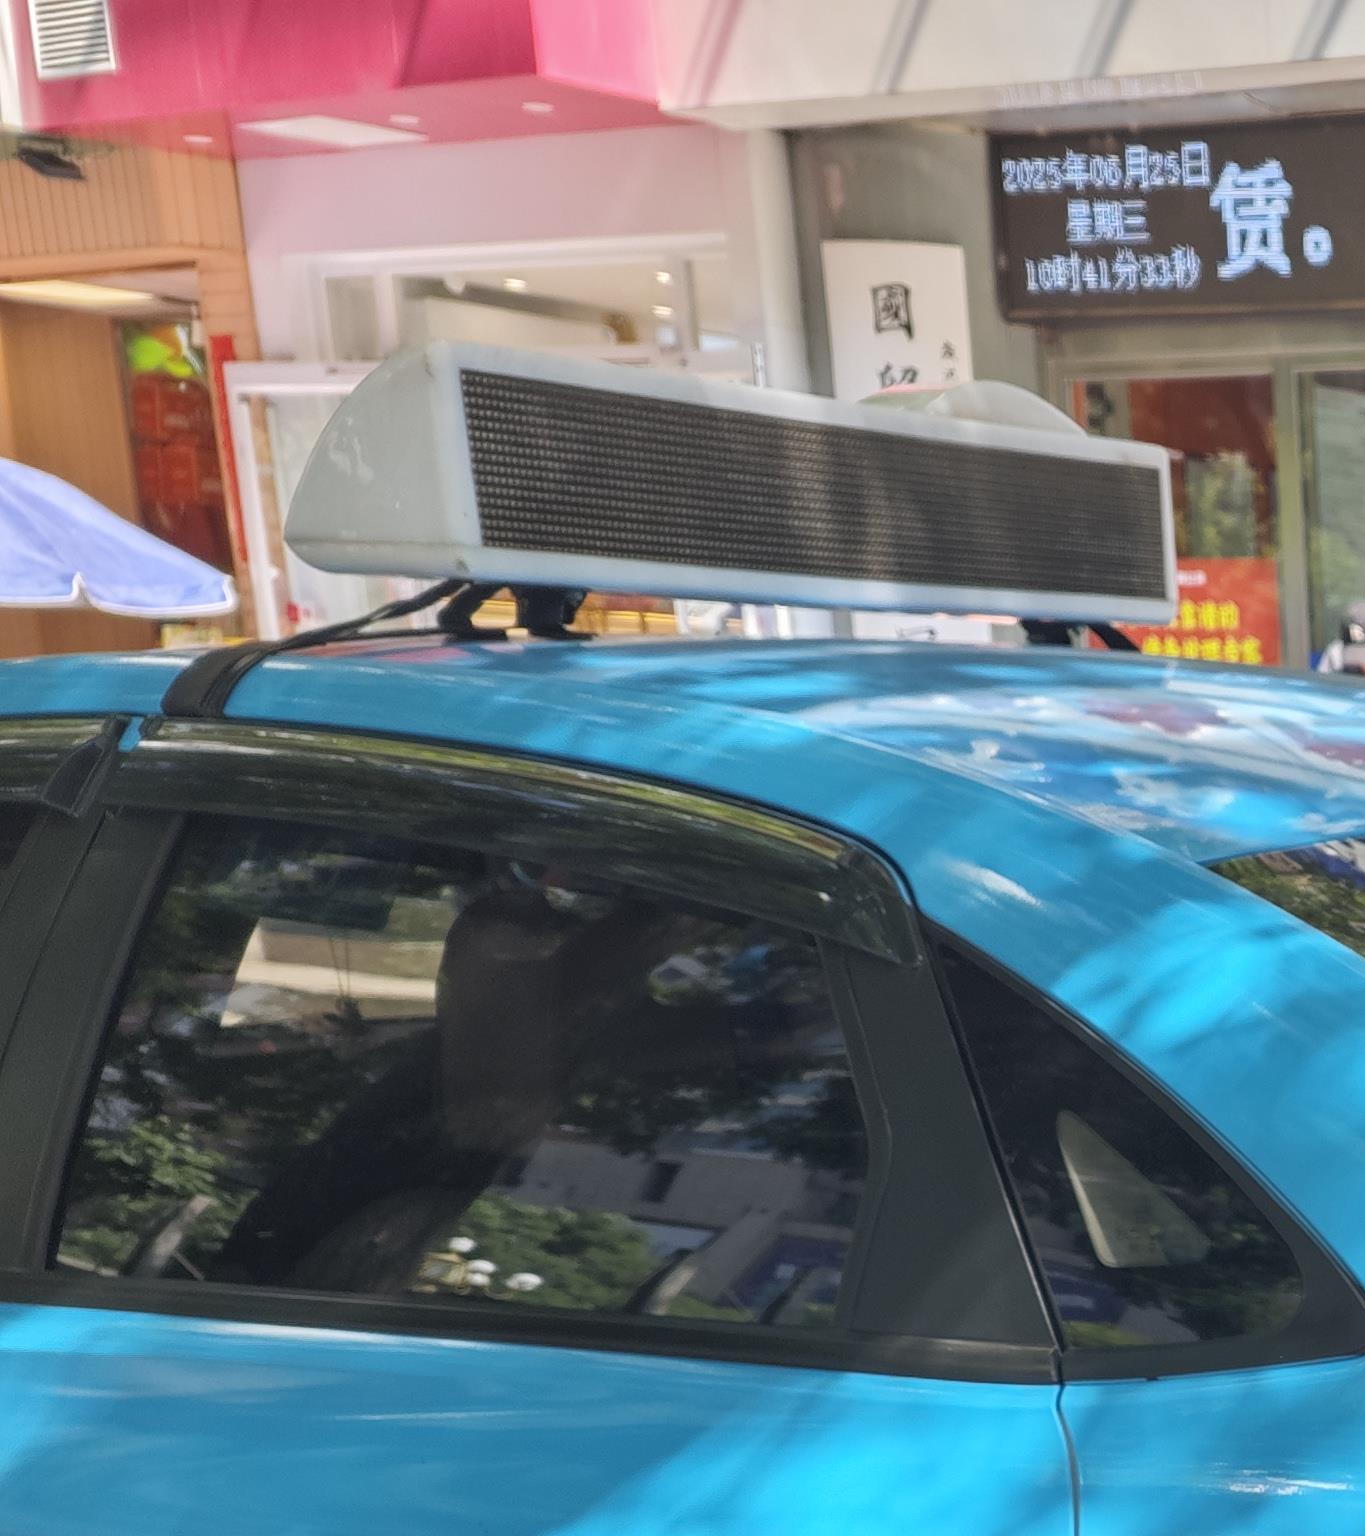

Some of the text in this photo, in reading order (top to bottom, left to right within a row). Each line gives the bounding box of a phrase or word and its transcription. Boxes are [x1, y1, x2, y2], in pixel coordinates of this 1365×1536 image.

[1002, 141, 1210, 194] 2025年06月25日
[1066, 197, 1151, 243] 星期三
